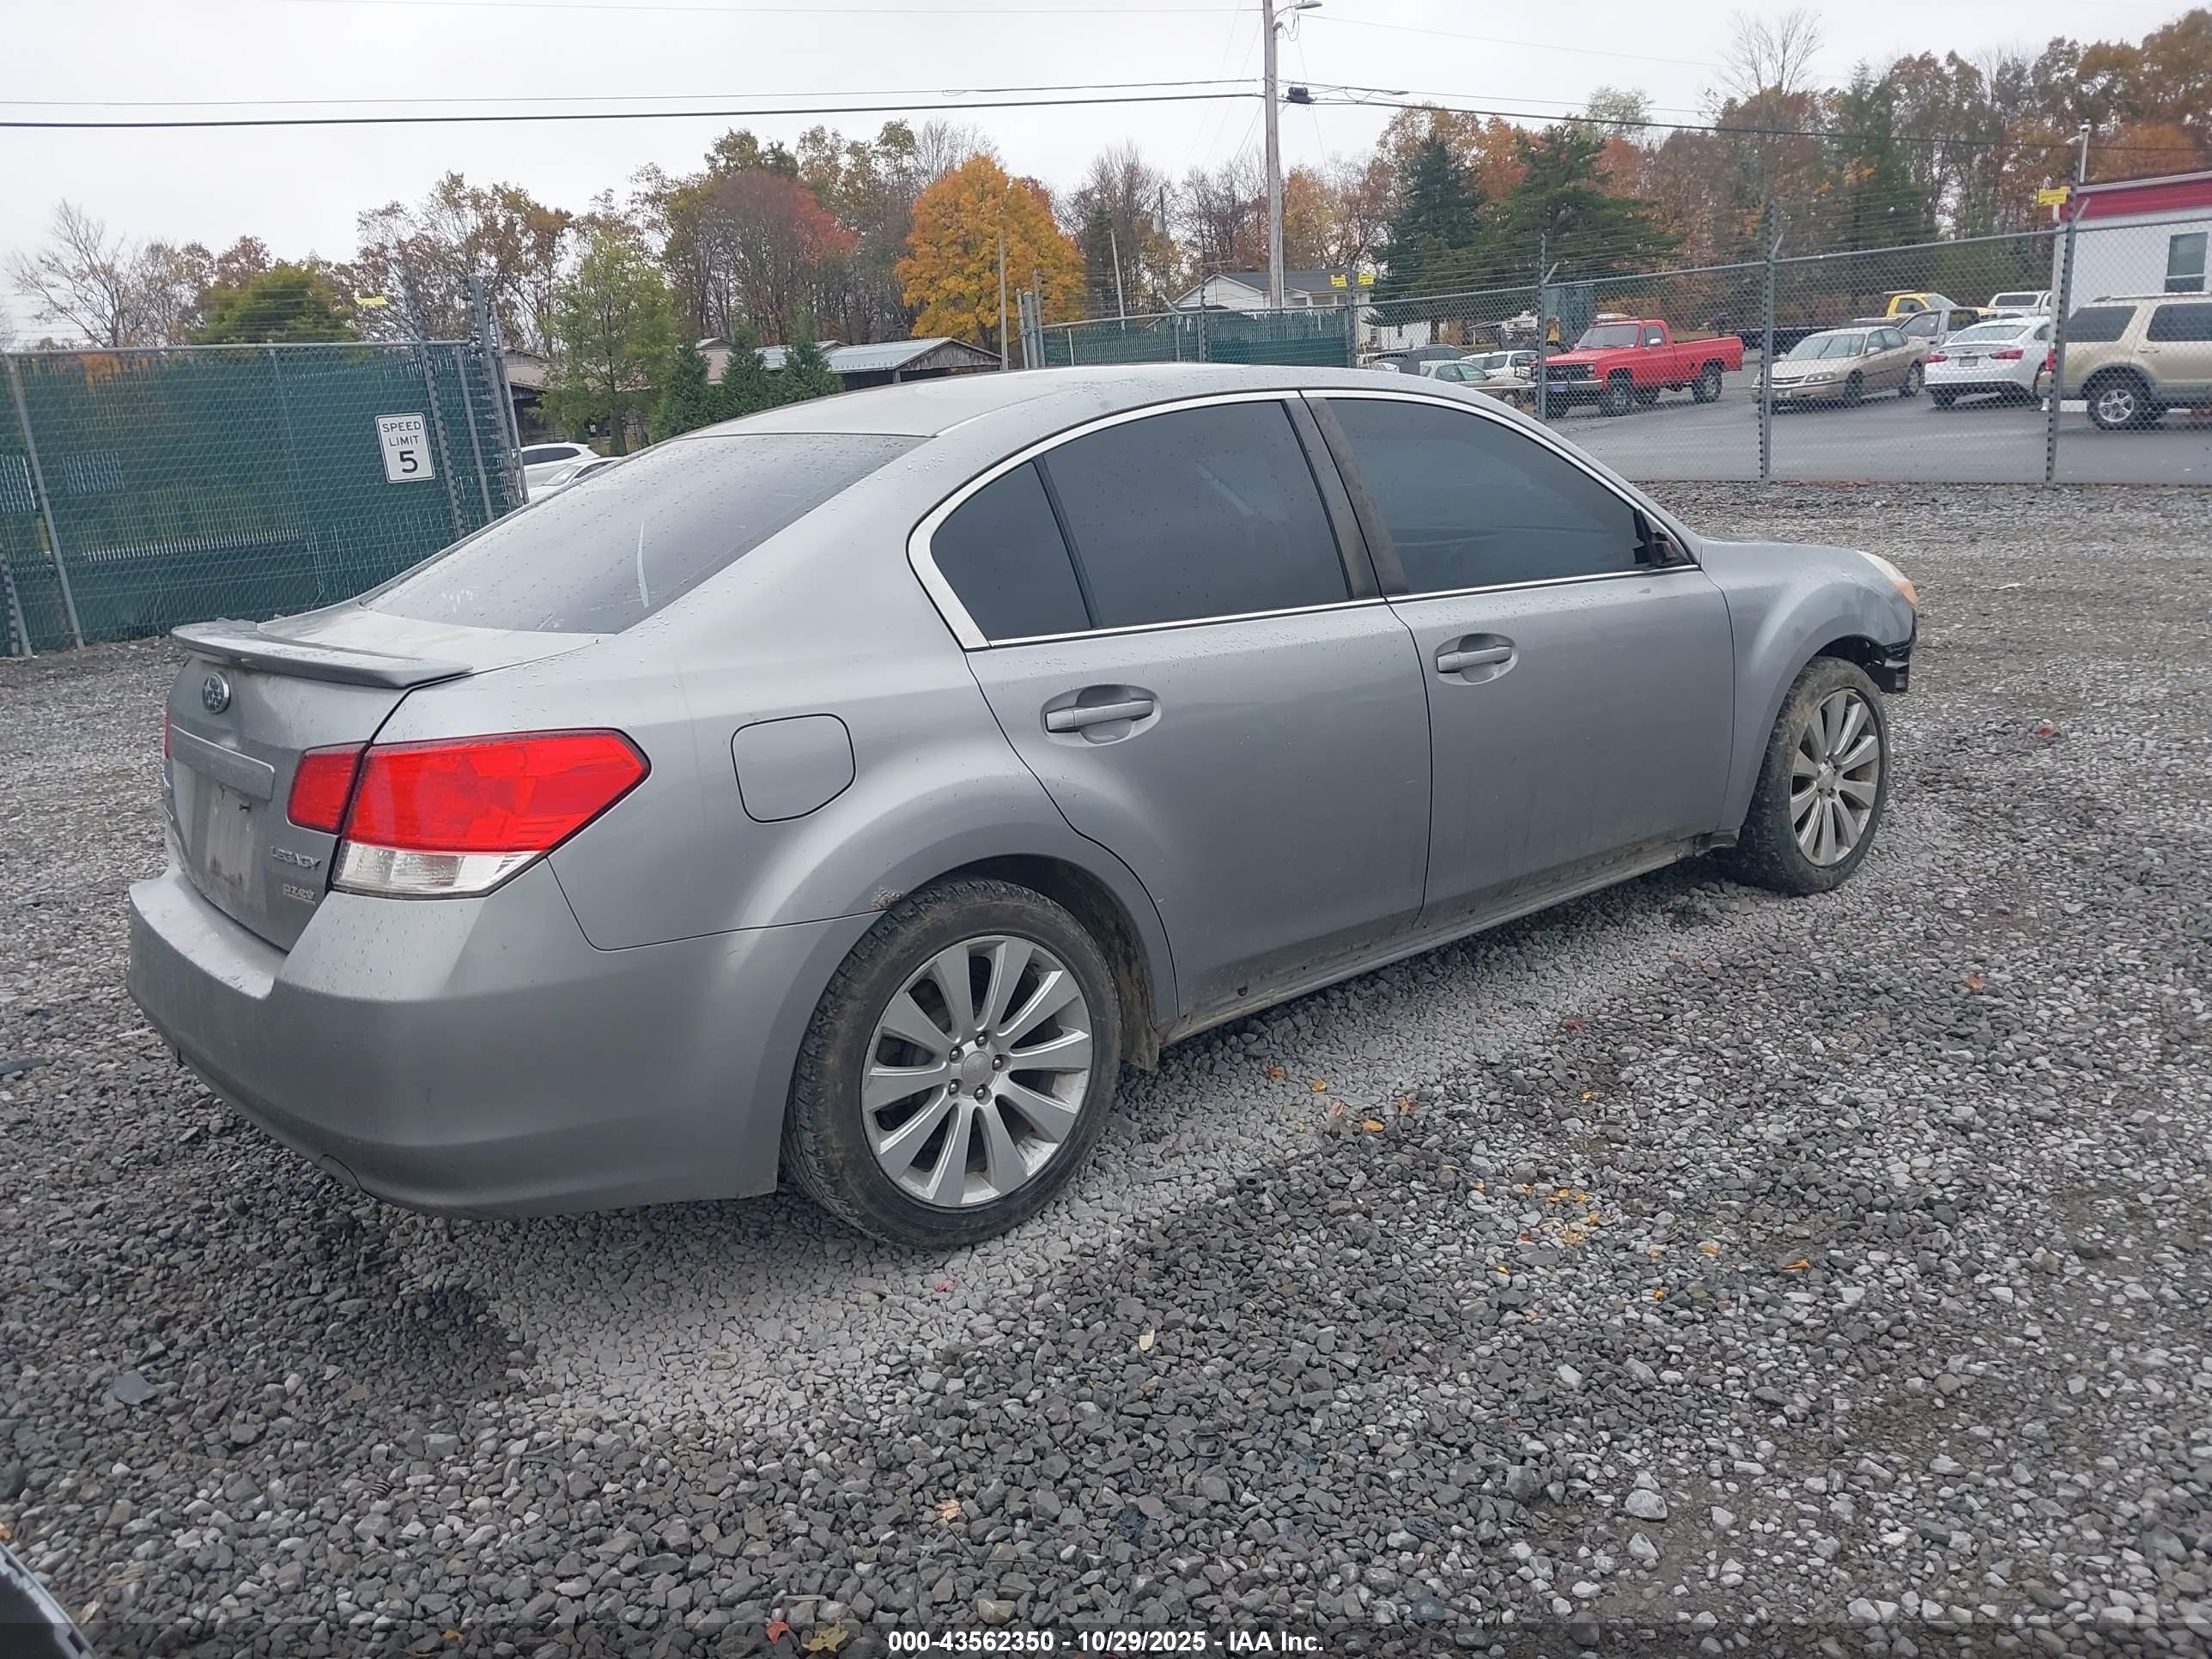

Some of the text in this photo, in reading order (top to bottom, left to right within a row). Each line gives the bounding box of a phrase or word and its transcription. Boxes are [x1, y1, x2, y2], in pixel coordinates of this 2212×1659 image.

[382, 421, 422, 433] SPEED
[388, 435, 419, 447] LIMIT
[399, 450, 418, 473] 5
[270, 845, 322, 871] LEGACY
